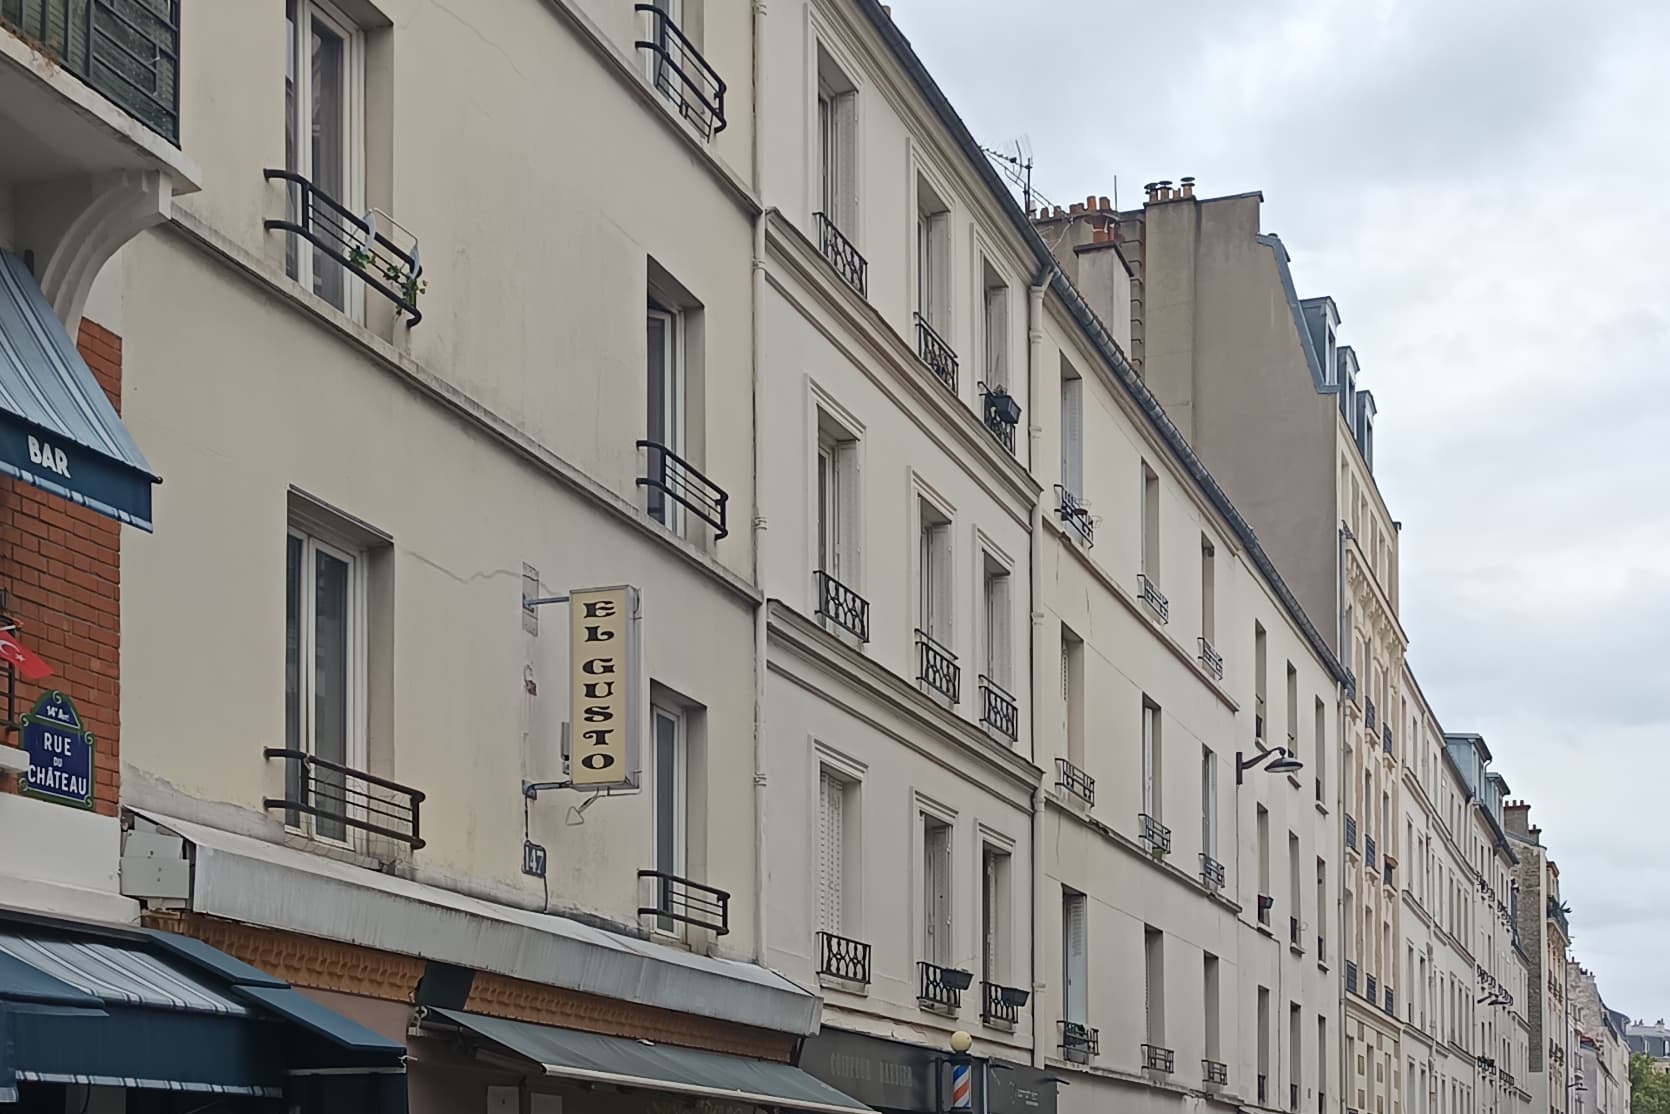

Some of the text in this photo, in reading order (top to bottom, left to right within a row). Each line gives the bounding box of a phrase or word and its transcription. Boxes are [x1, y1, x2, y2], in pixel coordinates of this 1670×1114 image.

[27, 434, 71, 479] BAR
[581, 600, 616, 770] EL GUSTO
[43, 732, 72, 756] RUE
[53, 756, 63, 767] DU
[27, 764, 87, 795] CHÂTEAU
[523, 846, 545, 874] 147
